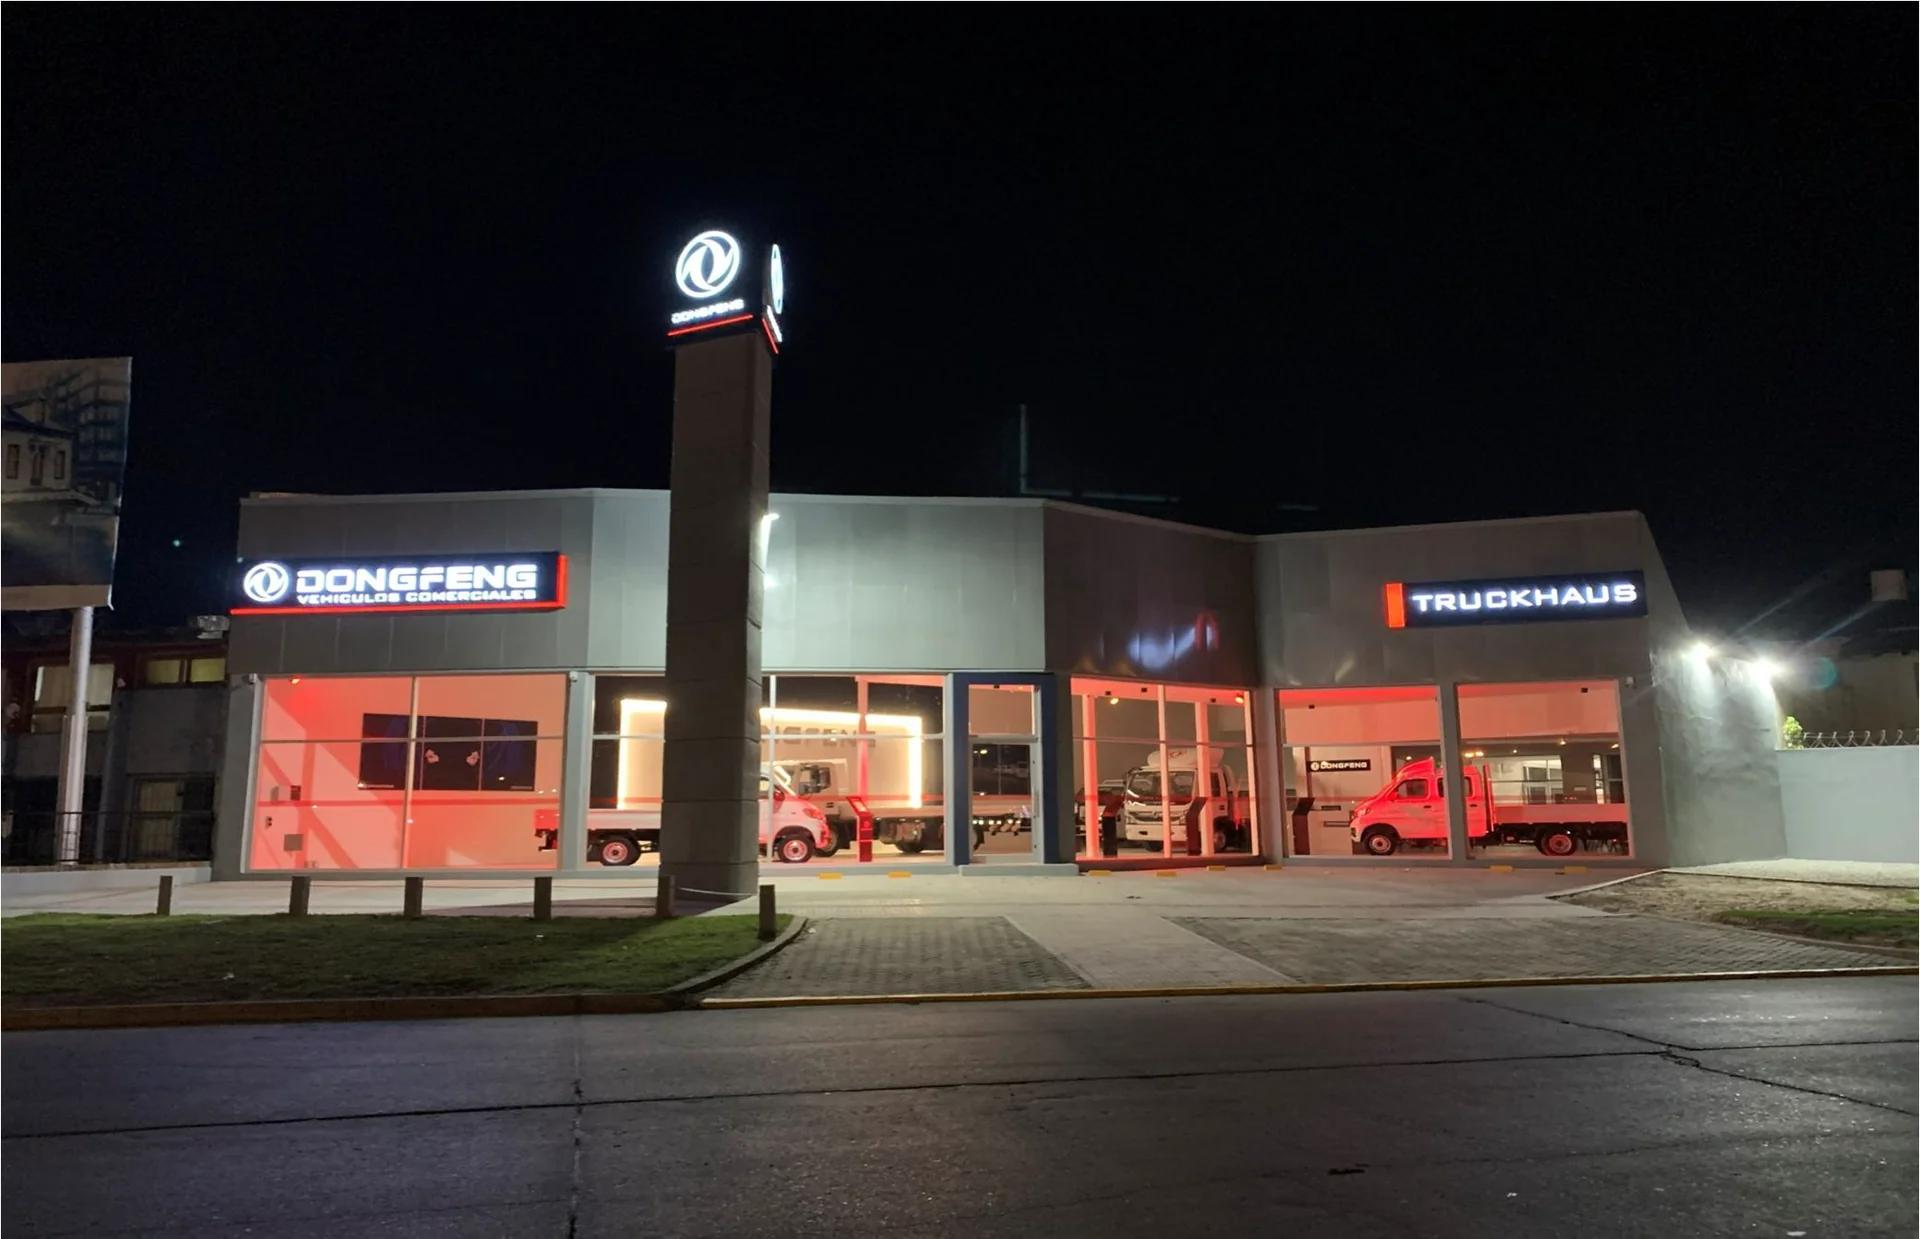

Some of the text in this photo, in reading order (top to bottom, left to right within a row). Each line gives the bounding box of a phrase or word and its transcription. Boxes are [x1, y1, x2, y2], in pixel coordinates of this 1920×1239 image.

[296, 564, 538, 593] DONGFENG
[296, 589, 537, 605] VEHICULOS COMERCIALES
[1412, 584, 1638, 612] TRUCKHAUS
